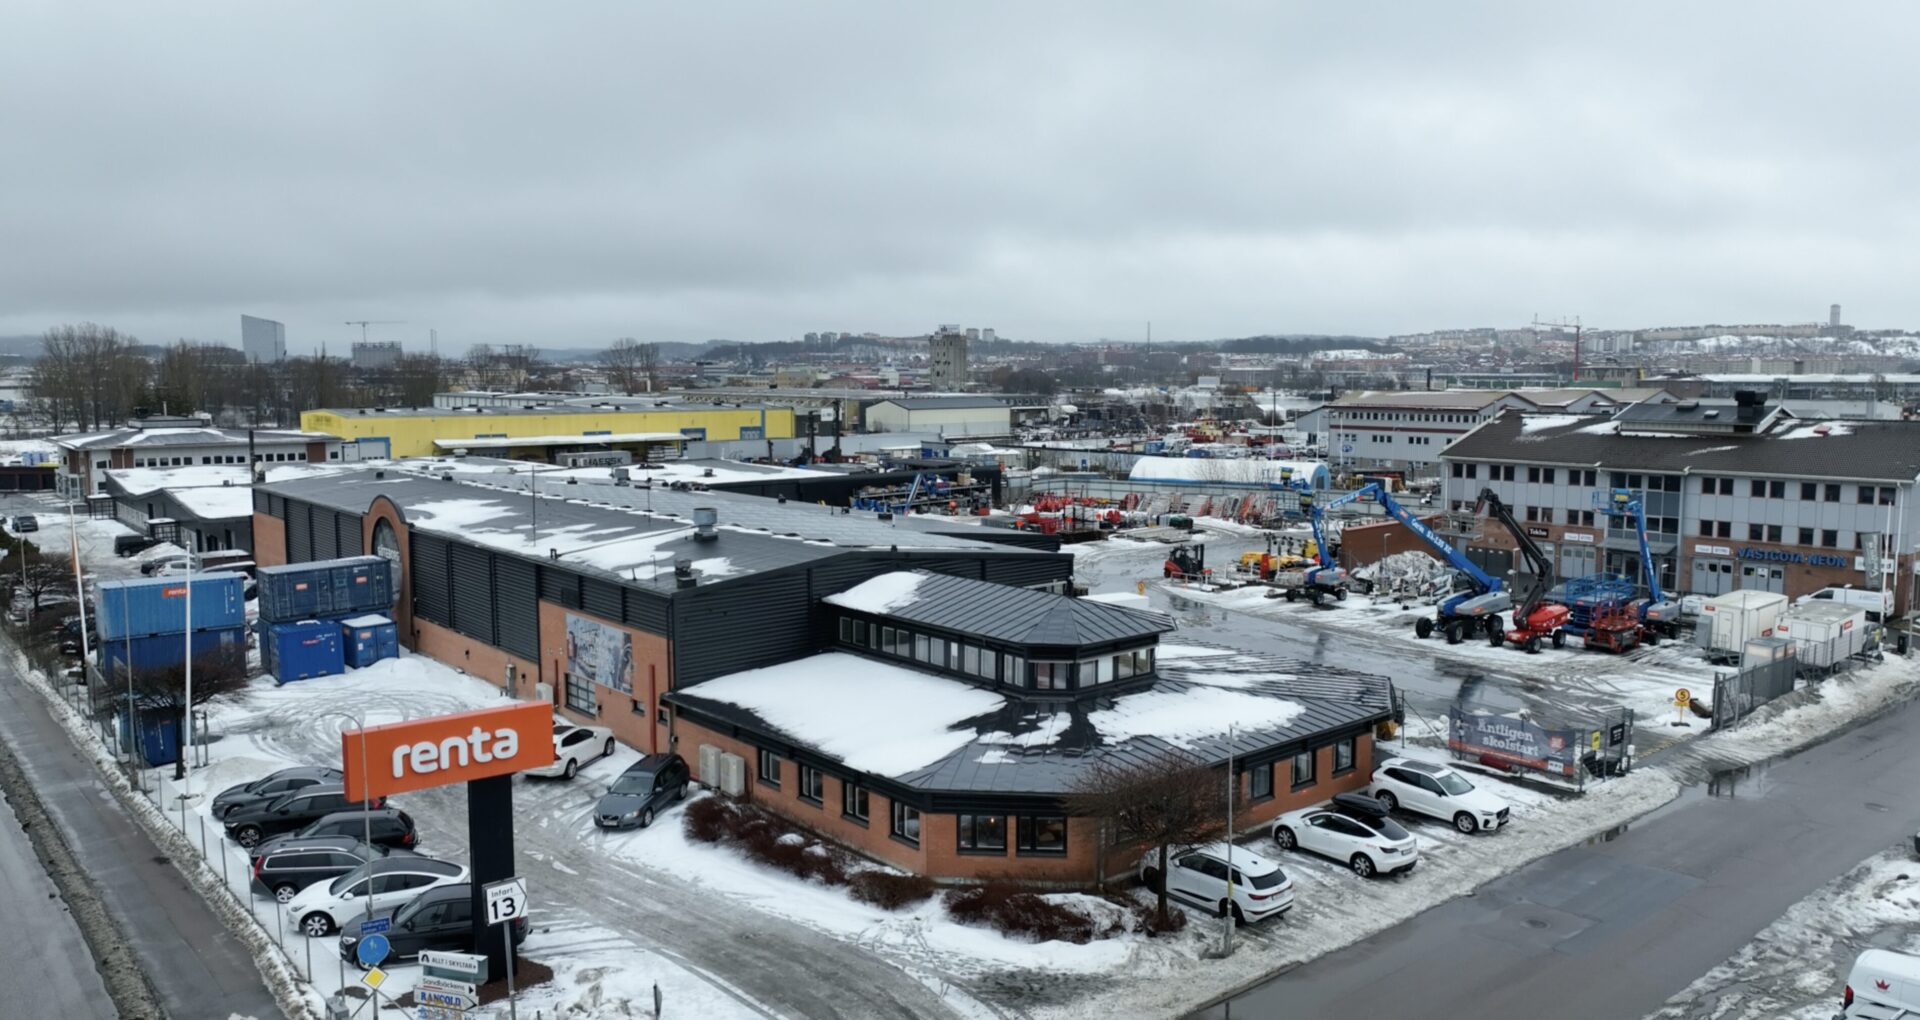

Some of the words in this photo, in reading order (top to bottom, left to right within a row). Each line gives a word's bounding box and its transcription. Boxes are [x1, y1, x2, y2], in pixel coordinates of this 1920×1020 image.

[392, 726, 519, 778] renta
[1482, 735, 1539, 757] skolstart
[491, 887, 513, 898] Infart
[491, 897, 516, 920] 13
[448, 960, 472, 969] SKYLTAR
